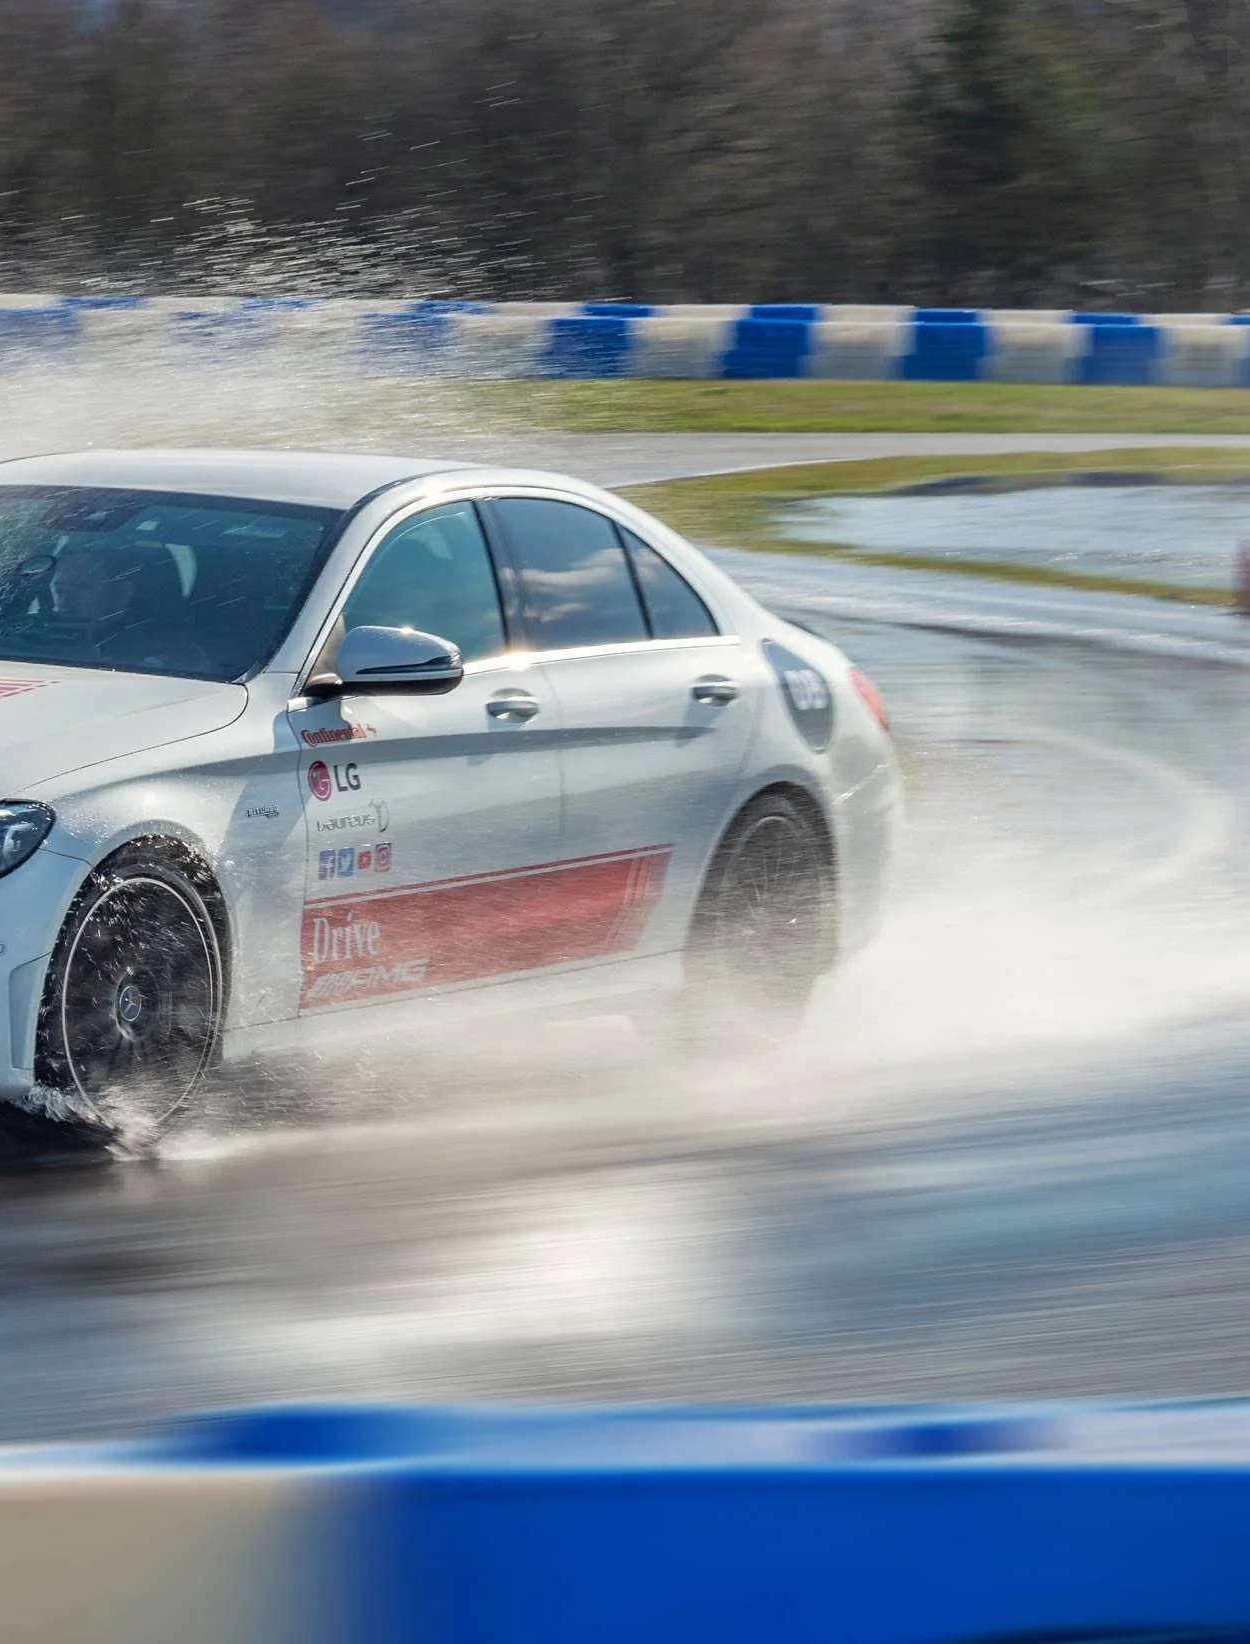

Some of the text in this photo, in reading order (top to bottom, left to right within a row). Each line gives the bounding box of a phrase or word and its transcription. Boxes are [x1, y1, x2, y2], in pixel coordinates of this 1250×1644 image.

[300, 723, 367, 748] Continental
[333, 762, 361, 792] LG
[312, 911, 381, 966] Drive
